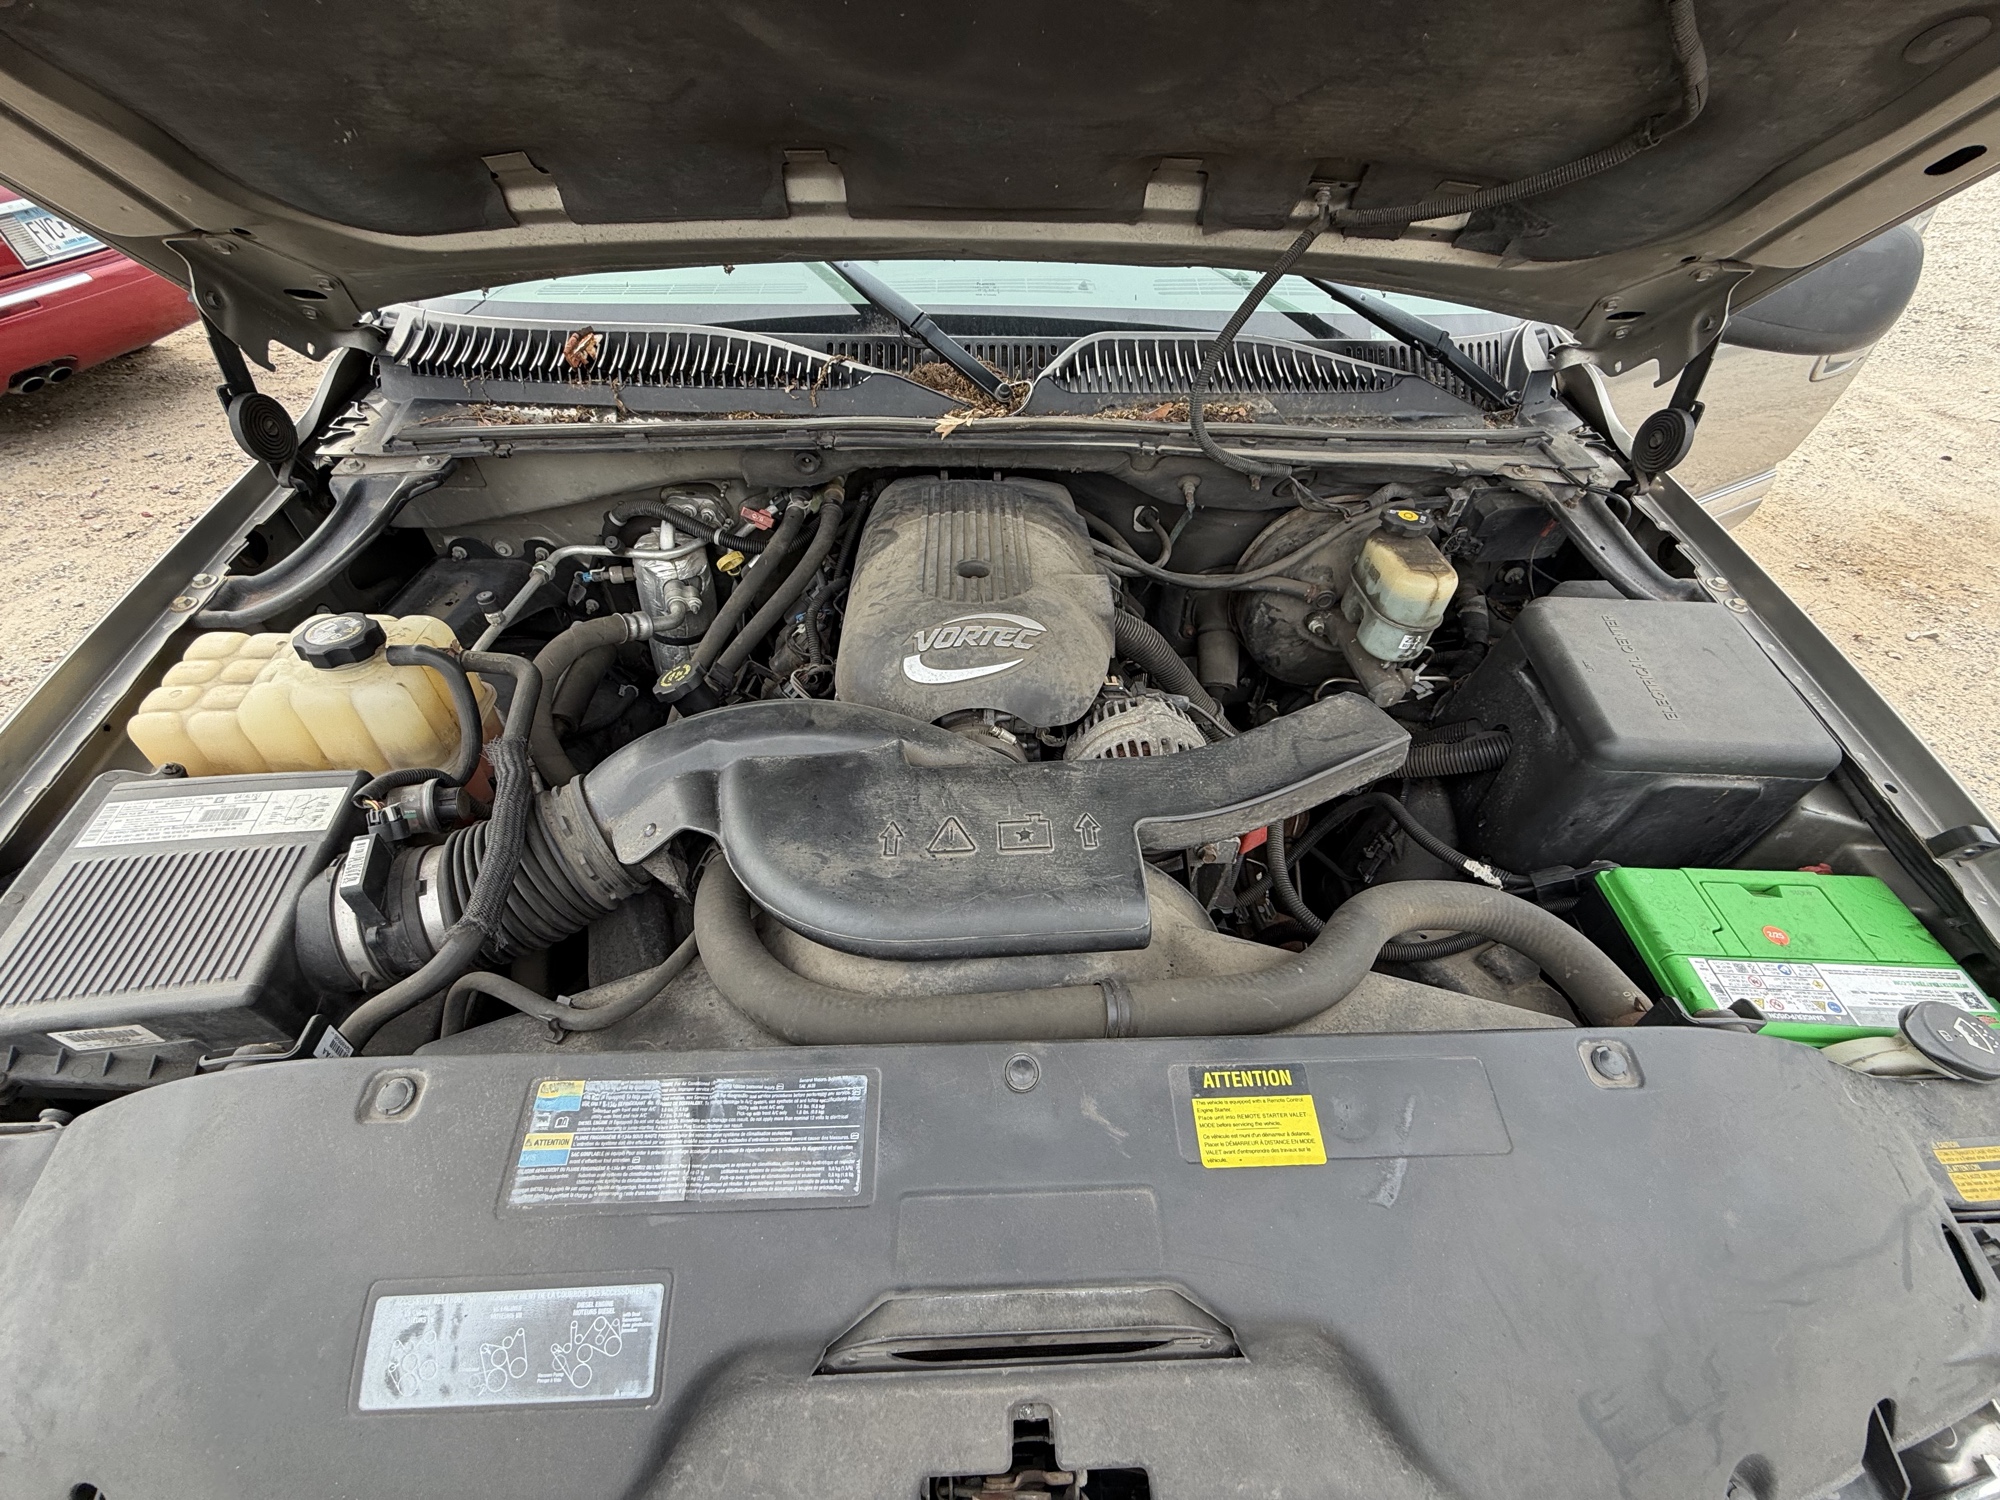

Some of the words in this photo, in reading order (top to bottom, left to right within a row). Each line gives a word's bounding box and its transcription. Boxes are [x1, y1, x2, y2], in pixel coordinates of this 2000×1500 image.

[25, 217, 66, 244] FVC
[913, 625, 1043, 652] VORTEC
[1601, 614, 1635, 654] CENTER
[1628, 656, 1681, 722] ELECTRICAL
[1766, 930, 1785, 940] 2/25
[1768, 1012, 1827, 1022] DANGER/POISON
[1203, 1069, 1292, 1089] ATTENTION
[533, 1138, 570, 1146] ATTENTION
